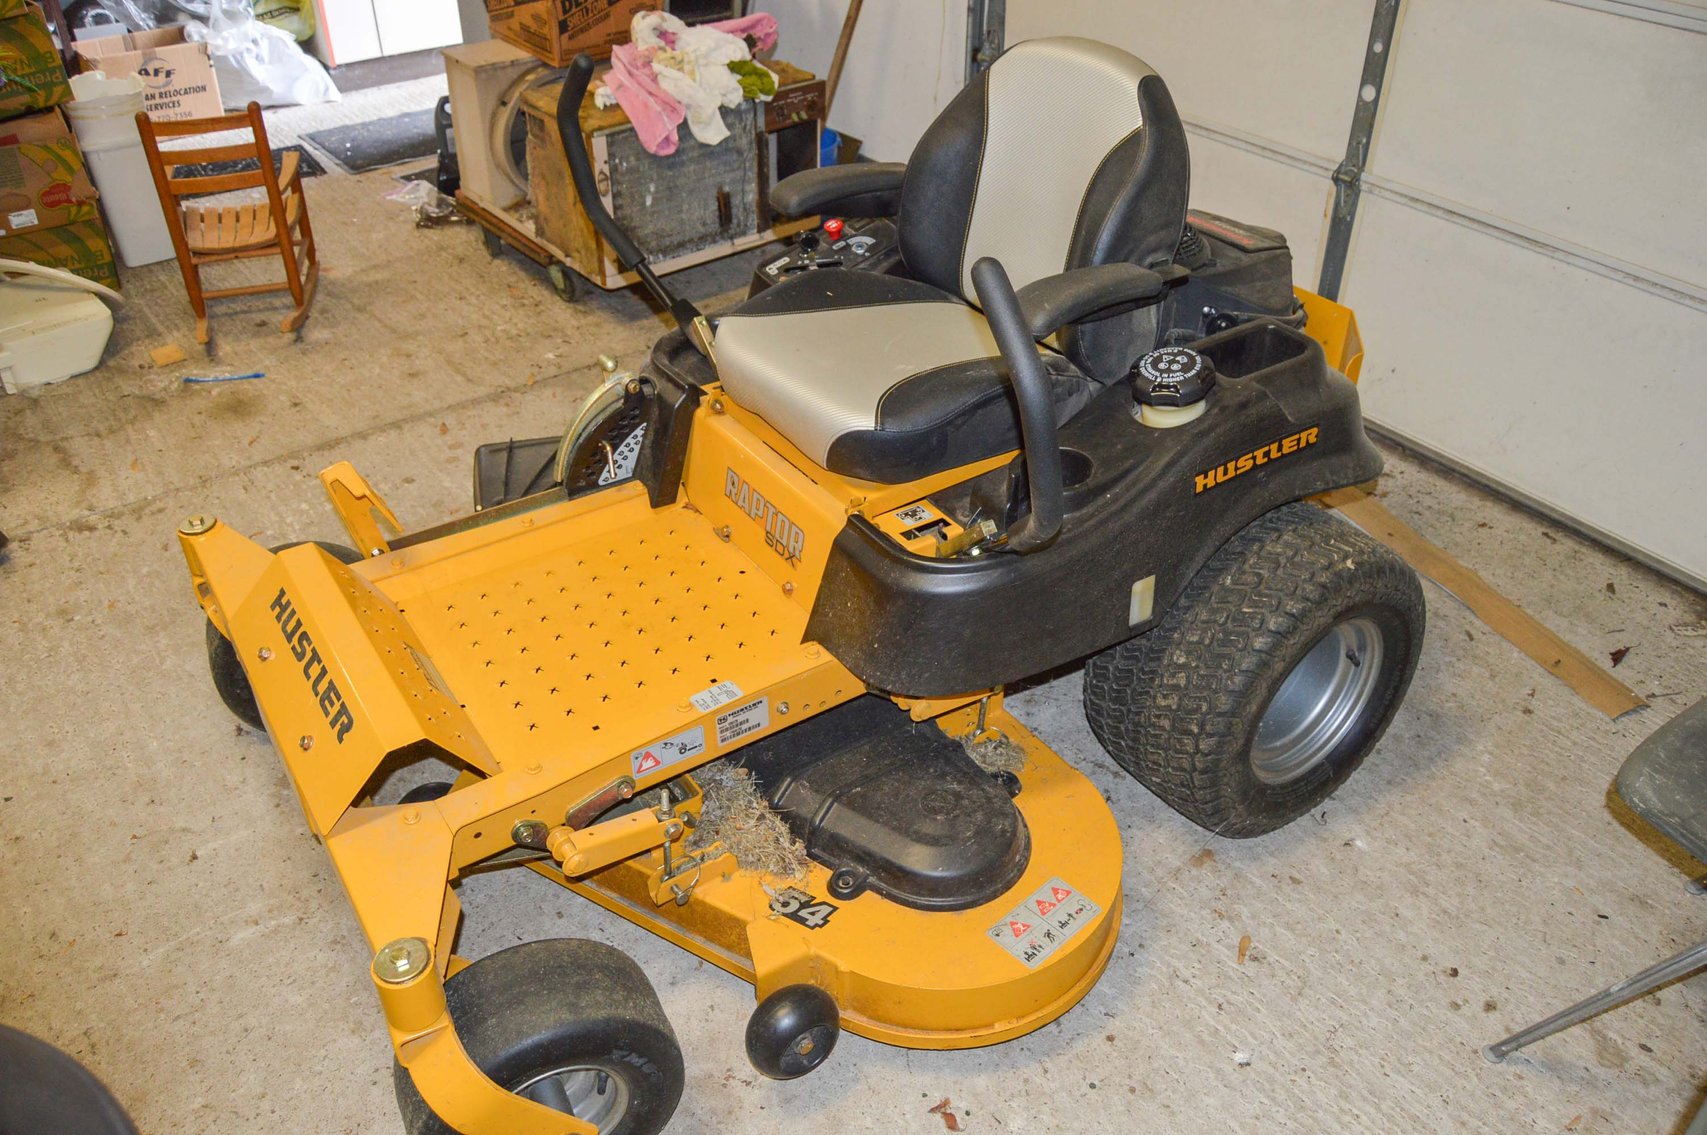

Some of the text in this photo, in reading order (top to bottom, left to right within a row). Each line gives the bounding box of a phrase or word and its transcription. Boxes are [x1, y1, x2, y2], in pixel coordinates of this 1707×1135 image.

[145, 99, 181, 112] SERVICES
[158, 85, 207, 99] RELOCATION
[1195, 426, 1320, 494] HUSTLER
[725, 467, 805, 562] RAPTOR
[765, 531, 796, 569] SDX
[270, 586, 354, 744] HUSTLER
[768, 886, 838, 930] 54
